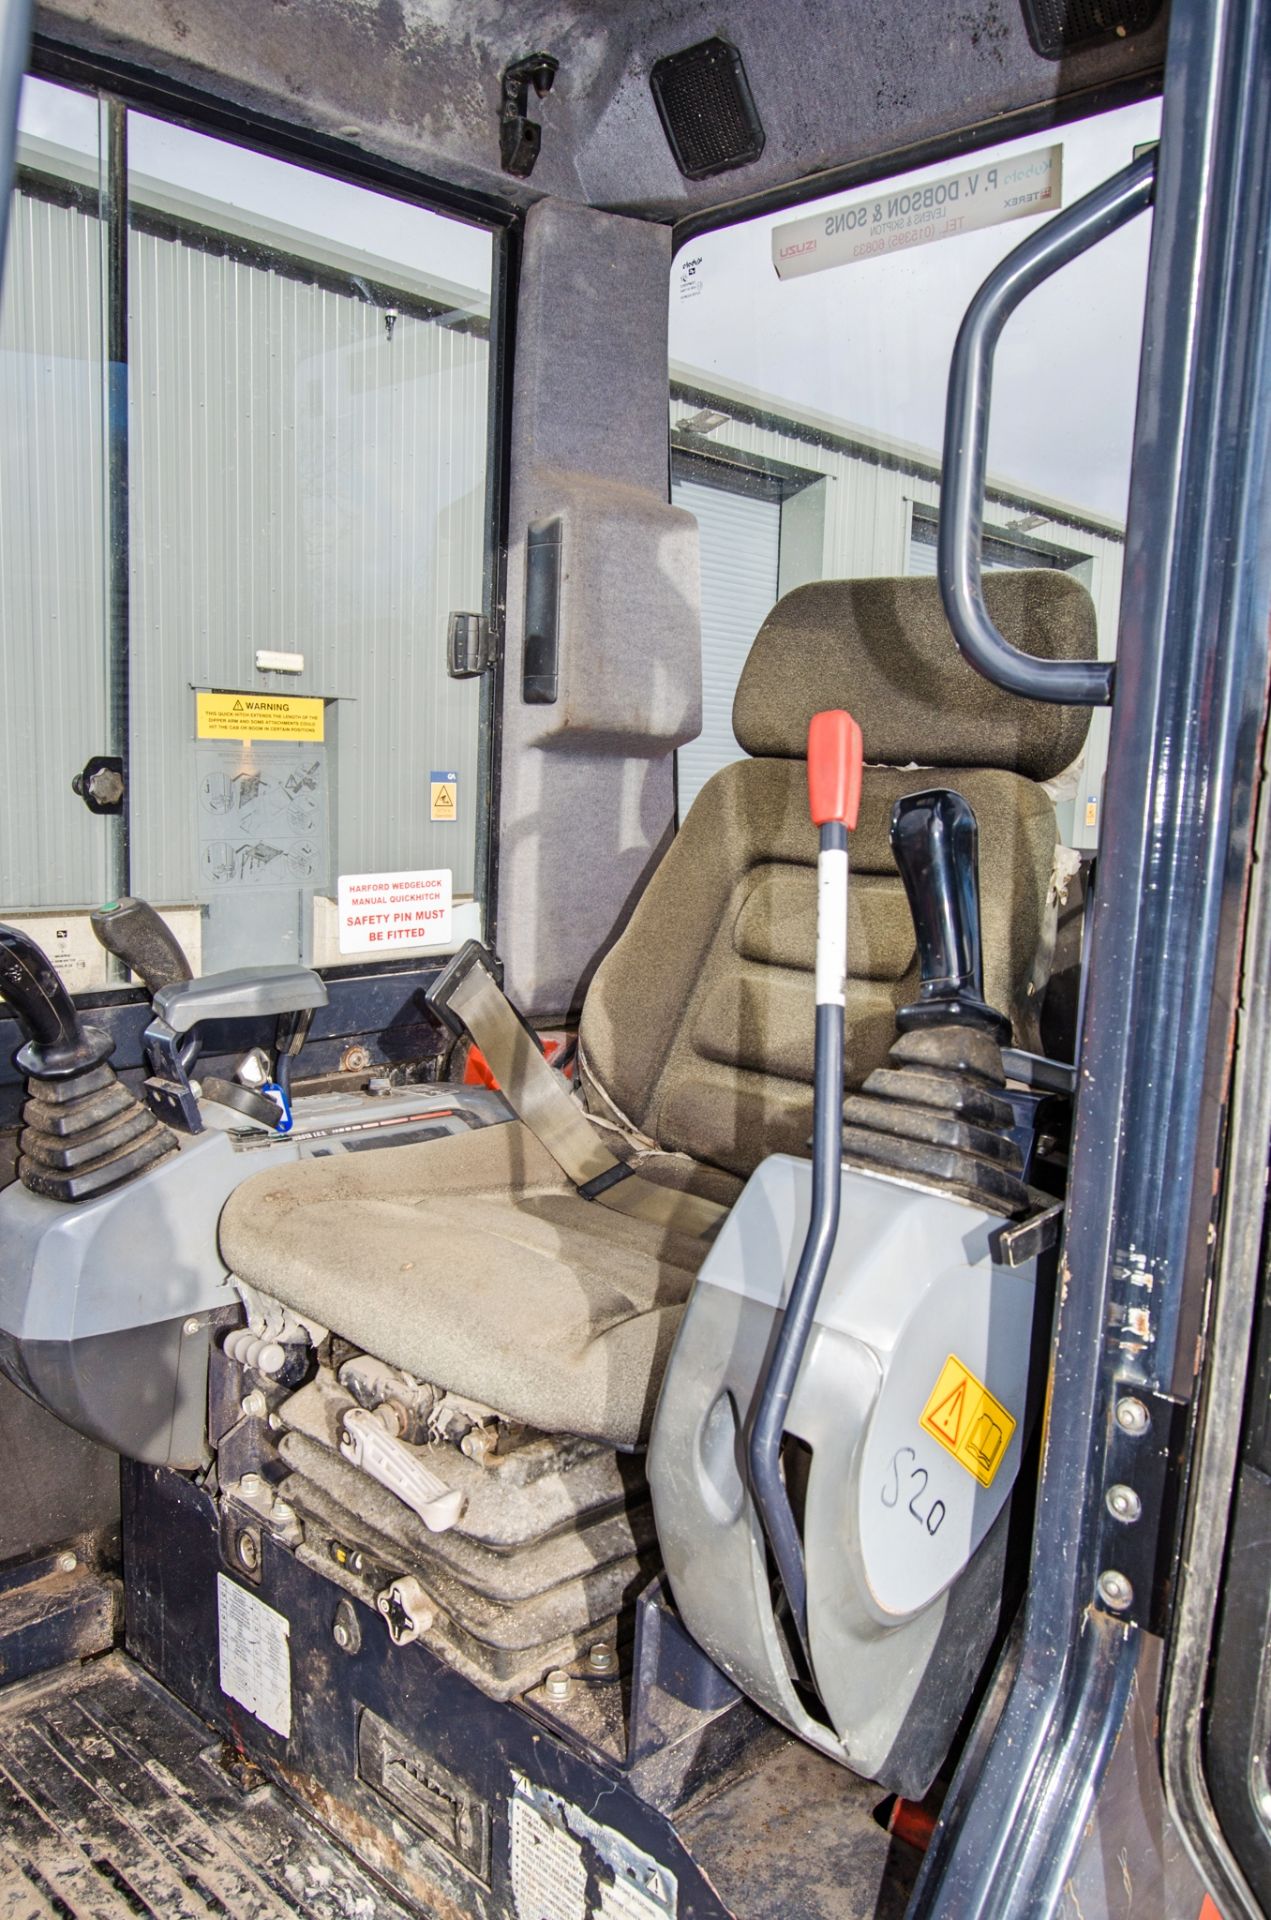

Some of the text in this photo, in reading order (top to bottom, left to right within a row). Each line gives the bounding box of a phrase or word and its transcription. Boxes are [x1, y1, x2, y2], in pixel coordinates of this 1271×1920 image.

[245, 702, 290, 712] WARNING
[349, 880, 442, 893] HARFORD WEDGELOCK
[351, 893, 441, 906] MANUAL QUICKHITCH
[346, 909, 445, 927] SAFETY PIN MUST
[369, 927, 425, 942] BE FITTED
